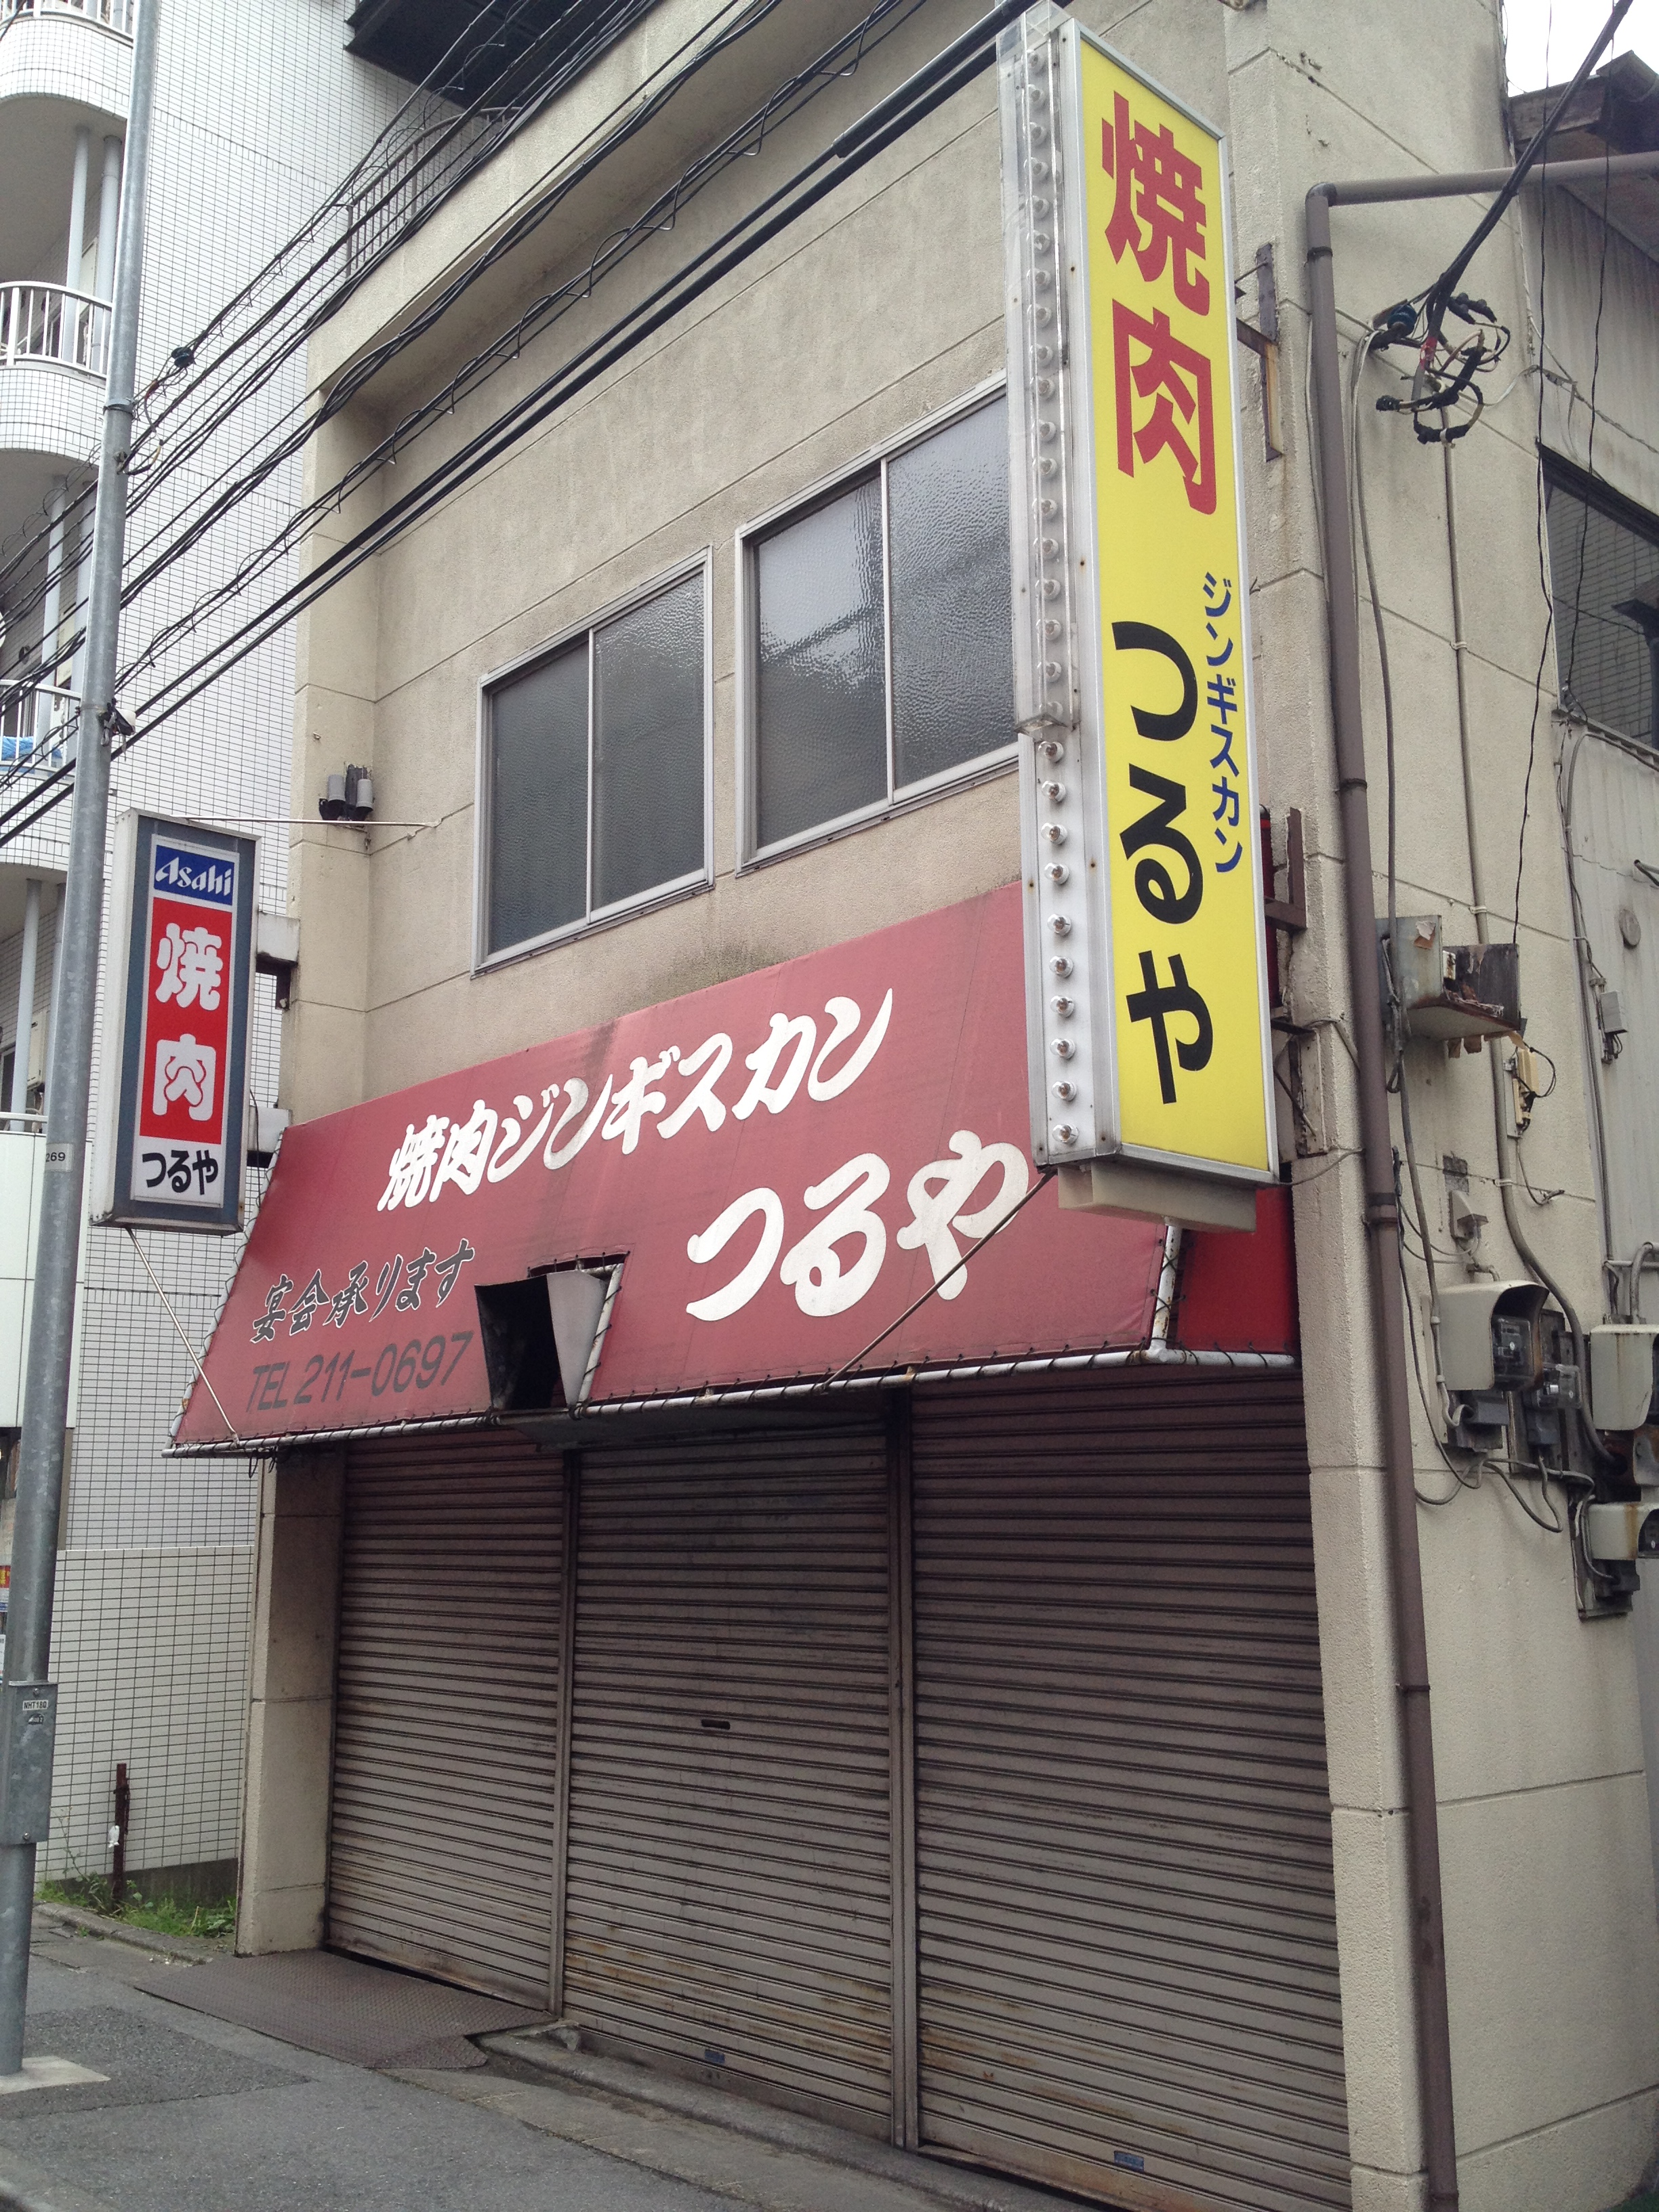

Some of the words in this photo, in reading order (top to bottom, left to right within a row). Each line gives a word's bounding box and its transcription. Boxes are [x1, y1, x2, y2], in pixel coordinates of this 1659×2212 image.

[1101, 90, 1217, 516] 焼肉
[1202, 571, 1243, 874] ジンギスカン
[155, 856, 232, 897] Asahi
[1111, 620, 1214, 1105] つるや
[152, 923, 222, 1121] 焼肉
[377, 987, 893, 1212] 焼肉ジンギスカン
[142, 1149, 219, 1195] つるや
[686, 1129, 1029, 1322] つるや
[246, 1361, 291, 1414] TEL
[293, 1330, 474, 1406] 211-0697
[250, 1237, 476, 1344] 宴会承ります
